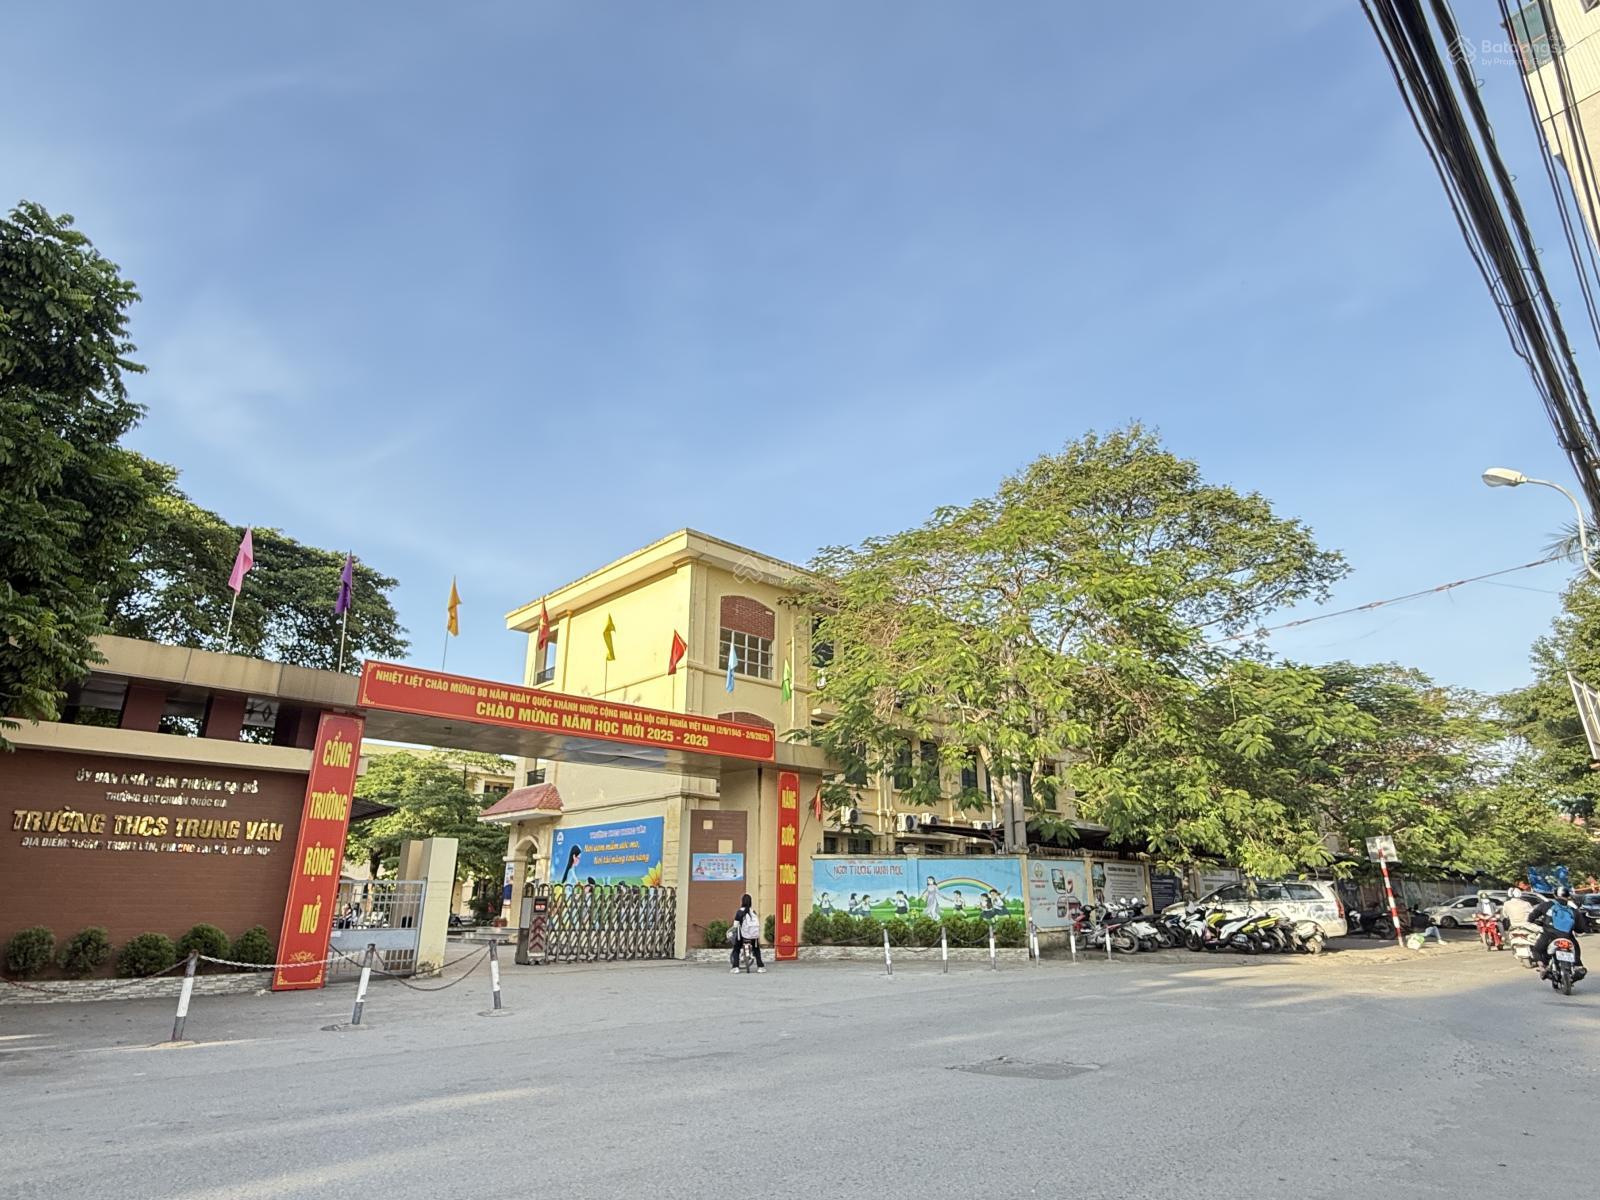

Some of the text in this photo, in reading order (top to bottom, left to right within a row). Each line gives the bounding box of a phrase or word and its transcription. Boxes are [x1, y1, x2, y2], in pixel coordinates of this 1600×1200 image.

[376, 670, 403, 685] NHIỆT
[404, 674, 424, 688] LIỆT
[425, 678, 448, 692] CHÀO
[477, 686, 488, 698] 80
[489, 688, 508, 701] NĂM
[510, 691, 530, 704] NGÀY
[532, 695, 552, 708] QUỐC
[554, 699, 578, 712] KHÁNH
[580, 703, 598, 715] NƯỚC
[600, 706, 618, 718] CỘNG
[644, 713, 654, 724] HỘI
[689, 720, 700, 732] VIỆT
[702, 722, 716, 734] NAM
[476, 701, 514, 720] CHÀO
[518, 708, 558, 726] MỪNG
[562, 713, 592, 730] NĂM
[594, 720, 618, 736] HỌC
[622, 722, 644, 738] MỚI
[646, 728, 674, 742] 2025
[683, 732, 708, 747] 2026
[323, 731, 352, 768] CỔNG
[106, 790, 141, 802] TRƯỜNG
[181, 777, 221, 791] PHƯỜNG
[309, 786, 348, 821] TRƯỜNG
[12, 805, 284, 841] TRƯỜNG THCS TRUNG VĂN
[303, 842, 335, 882] RỘNG
[299, 895, 322, 934] MỞ
